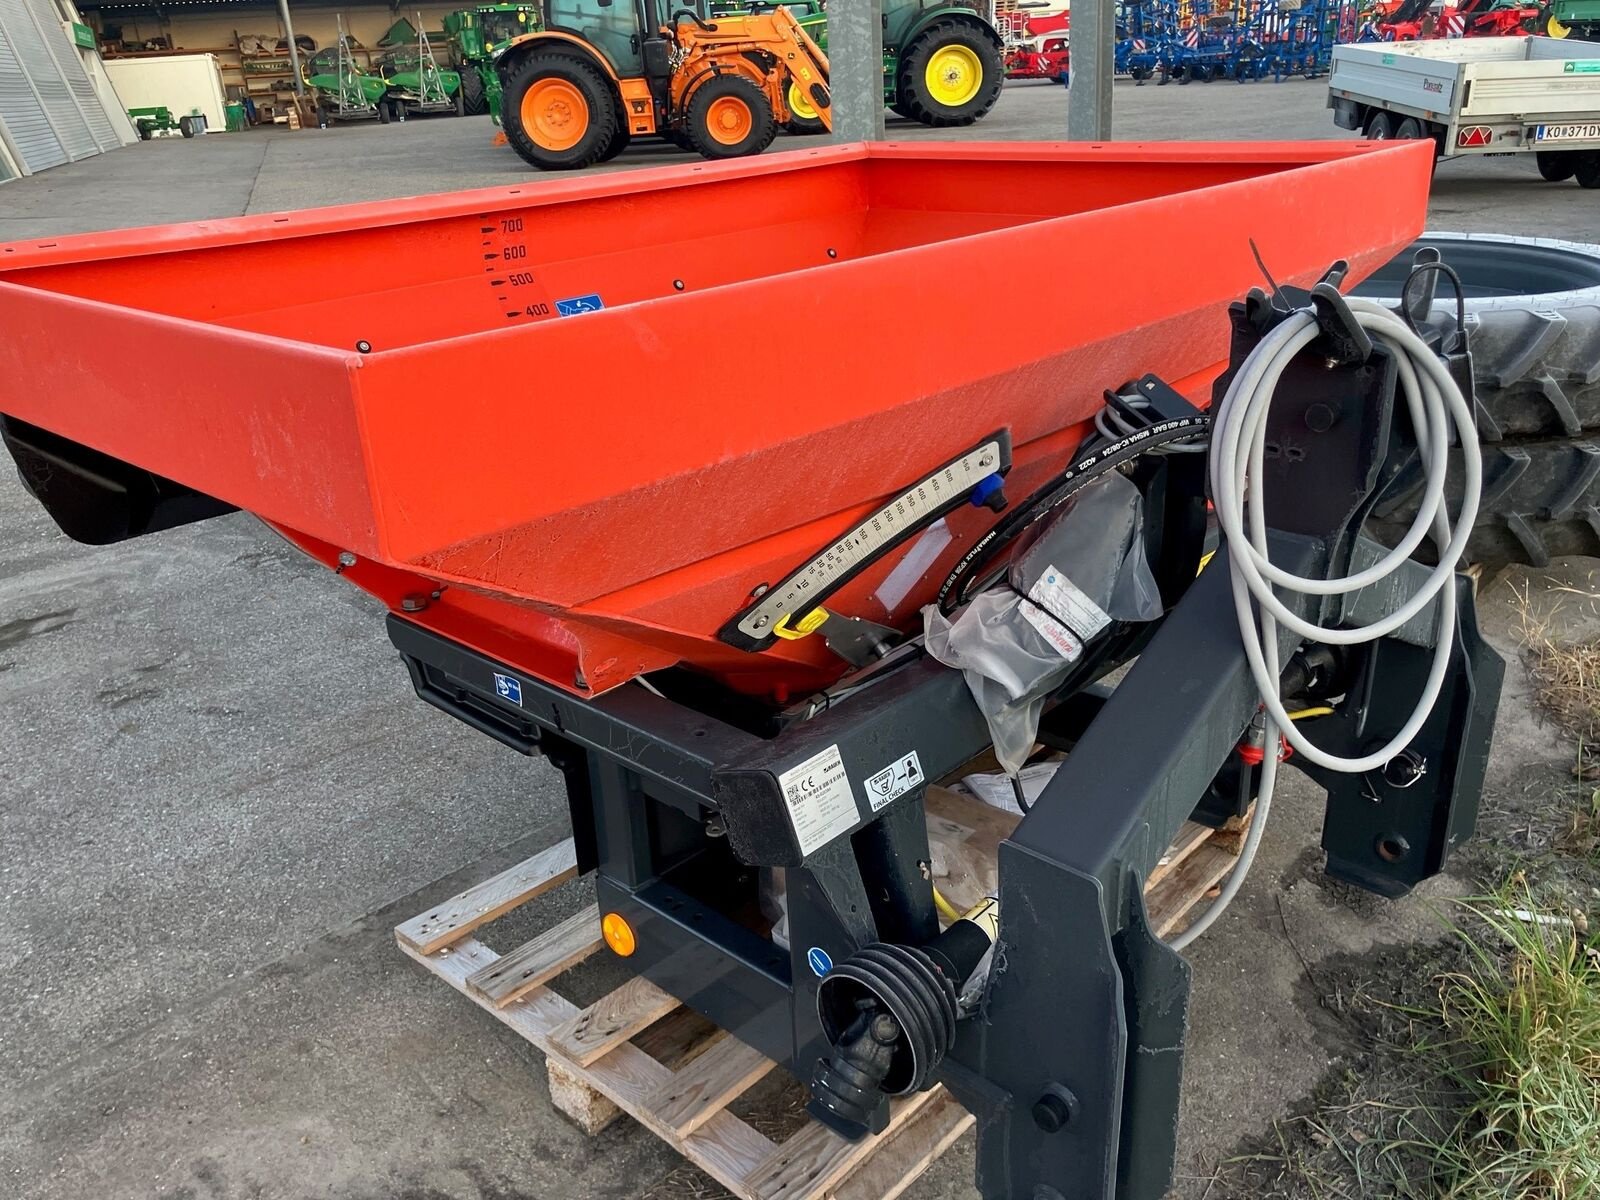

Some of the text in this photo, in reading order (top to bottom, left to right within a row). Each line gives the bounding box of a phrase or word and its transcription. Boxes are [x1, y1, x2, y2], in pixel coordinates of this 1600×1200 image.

[1546, 126, 1561, 138] KO
[501, 218, 523, 233] 700
[503, 245, 526, 260] 600
[509, 272, 534, 286] 500
[526, 303, 549, 317] 400
[1153, 423, 1168, 434] BAR
[1130, 430, 1150, 444] MSHA
[961, 458, 970, 472] 550
[1078, 456, 1096, 471] 4Q22
[944, 469, 954, 482] 500
[931, 478, 940, 491] 450
[906, 493, 916, 507] 350
[917, 487, 927, 500] 400
[895, 502, 905, 515] 300
[883, 509, 894, 522] 250
[871, 519, 882, 531] 200
[858, 528, 868, 540] 150
[835, 544, 845, 554] 80
[843, 539, 854, 551] 100
[816, 559, 825, 568] 30
[825, 552, 834, 562] 50
[807, 566, 816, 575] 15
[800, 579, 809, 588] 10
[775, 601, 783, 609] 0
[801, 775, 815, 791] CE
[873, 785, 906, 810] FINAL CHECK
